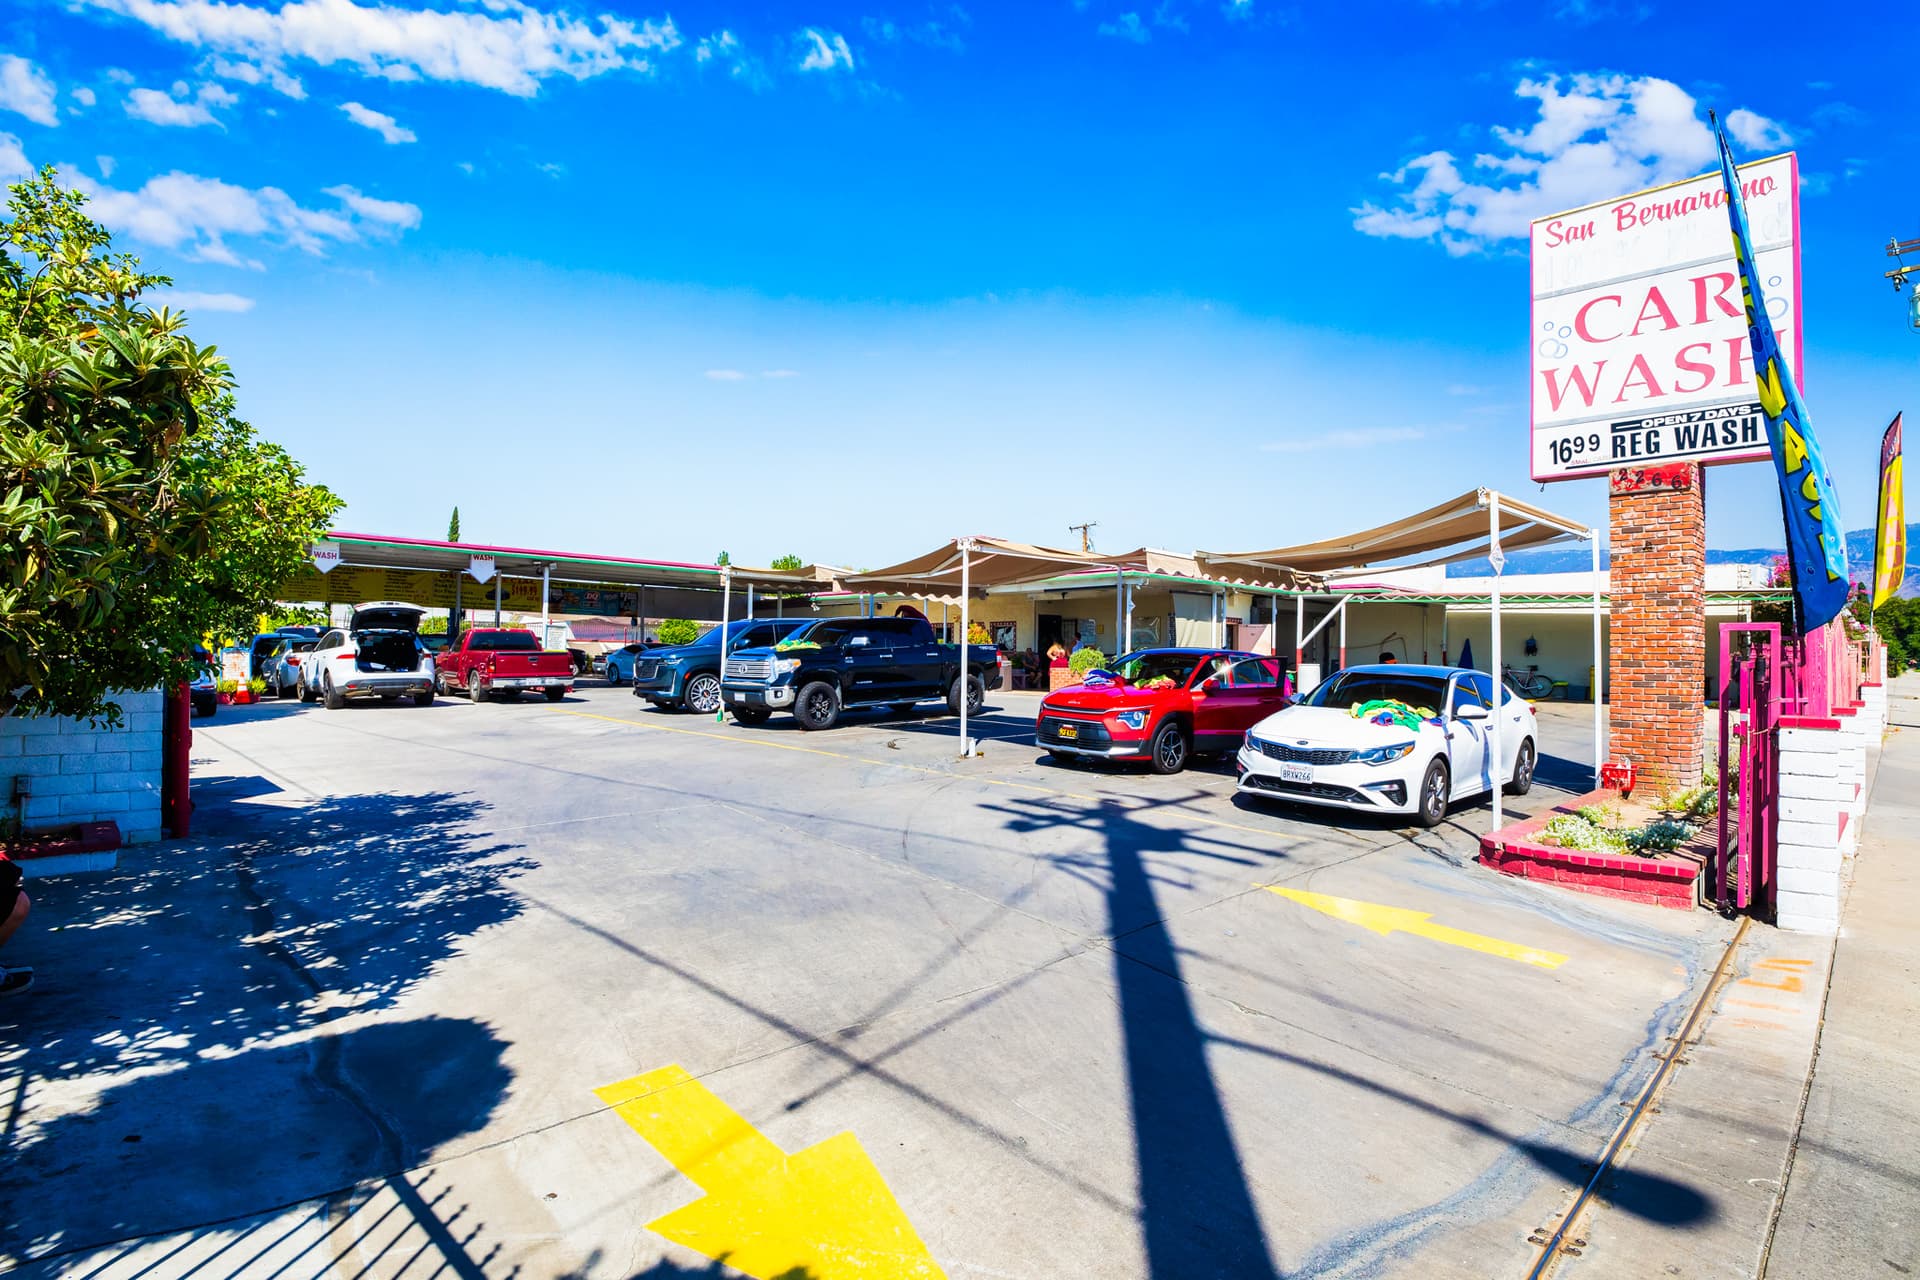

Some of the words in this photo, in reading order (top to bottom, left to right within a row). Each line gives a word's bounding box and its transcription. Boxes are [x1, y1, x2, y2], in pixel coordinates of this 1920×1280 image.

[1545, 221, 1595, 248] San
[1574, 271, 1744, 344] CAR
[1641, 413, 1688, 429] OPEN
[1688, 411, 1702, 422] 7
[1704, 405, 1752, 420] DAYS
[1611, 429, 1660, 459] REG
[1674, 415, 1758, 451] WASH
[313, 551, 337, 560] WASH
